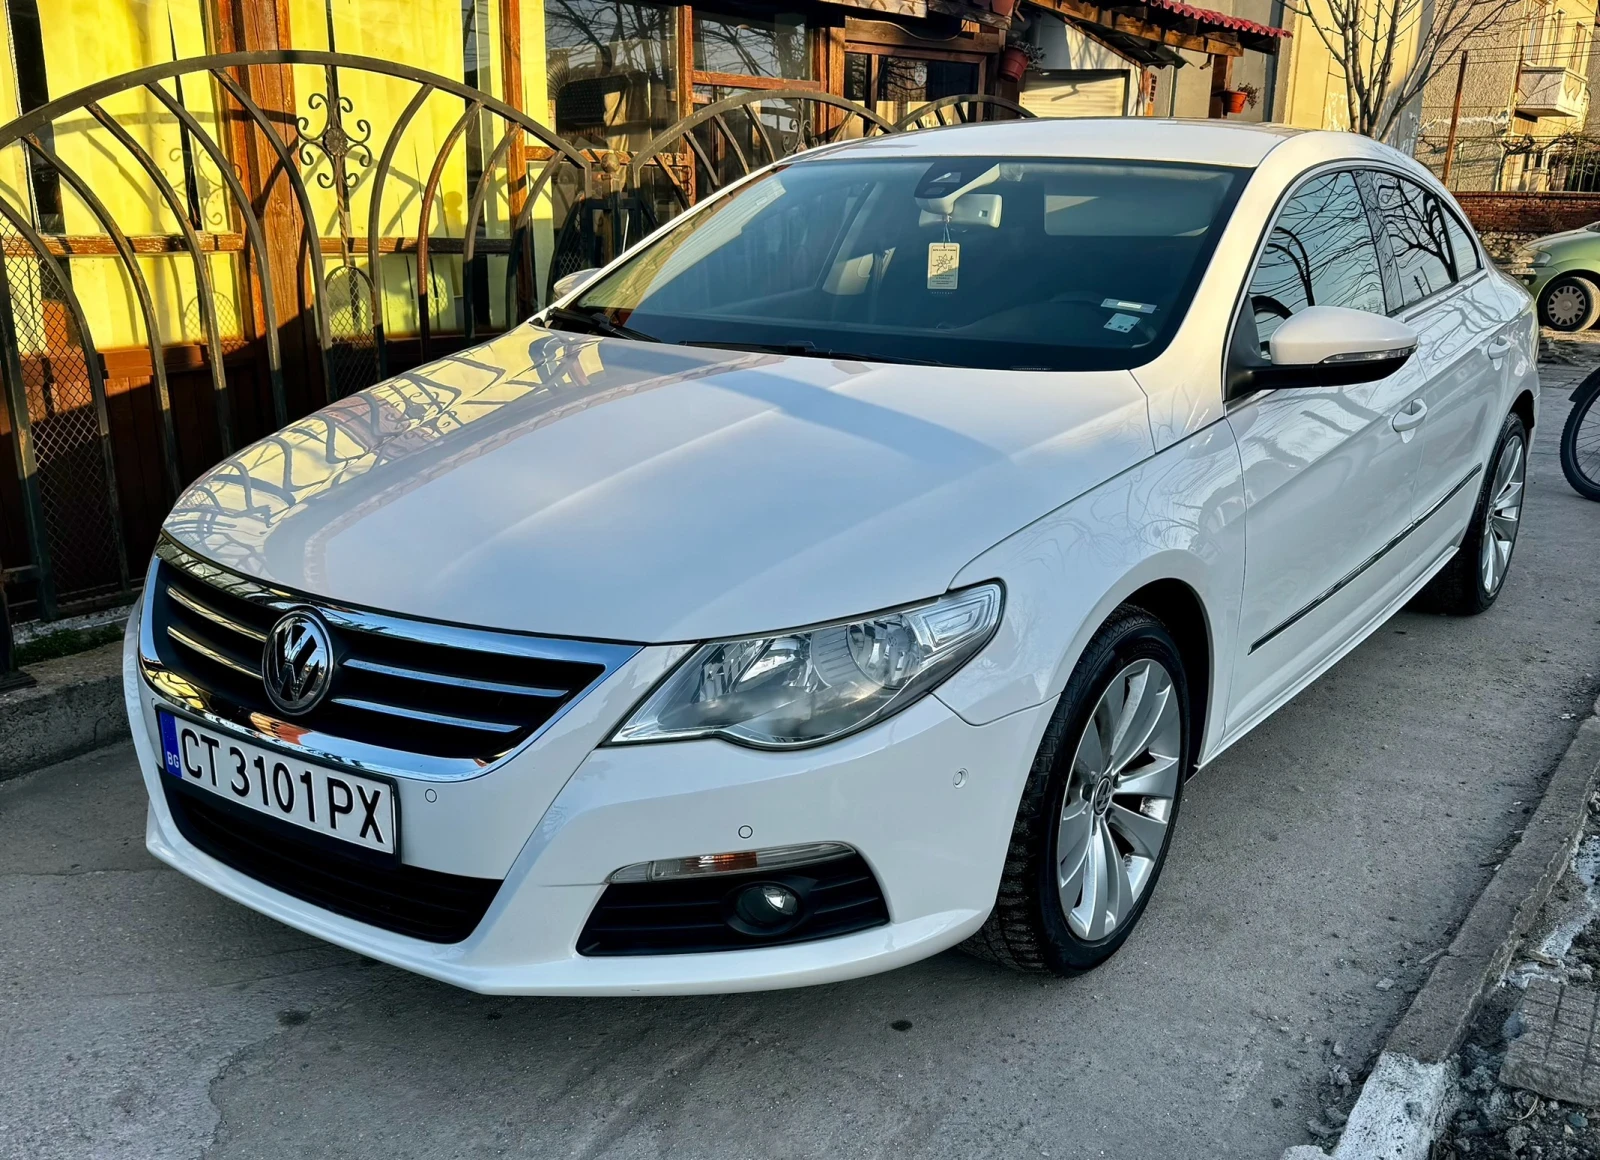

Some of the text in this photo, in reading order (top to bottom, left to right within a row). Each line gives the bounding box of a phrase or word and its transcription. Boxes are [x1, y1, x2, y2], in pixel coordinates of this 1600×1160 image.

[166, 751, 179, 769] BG
[181, 728, 385, 844] CT 3101 PX
